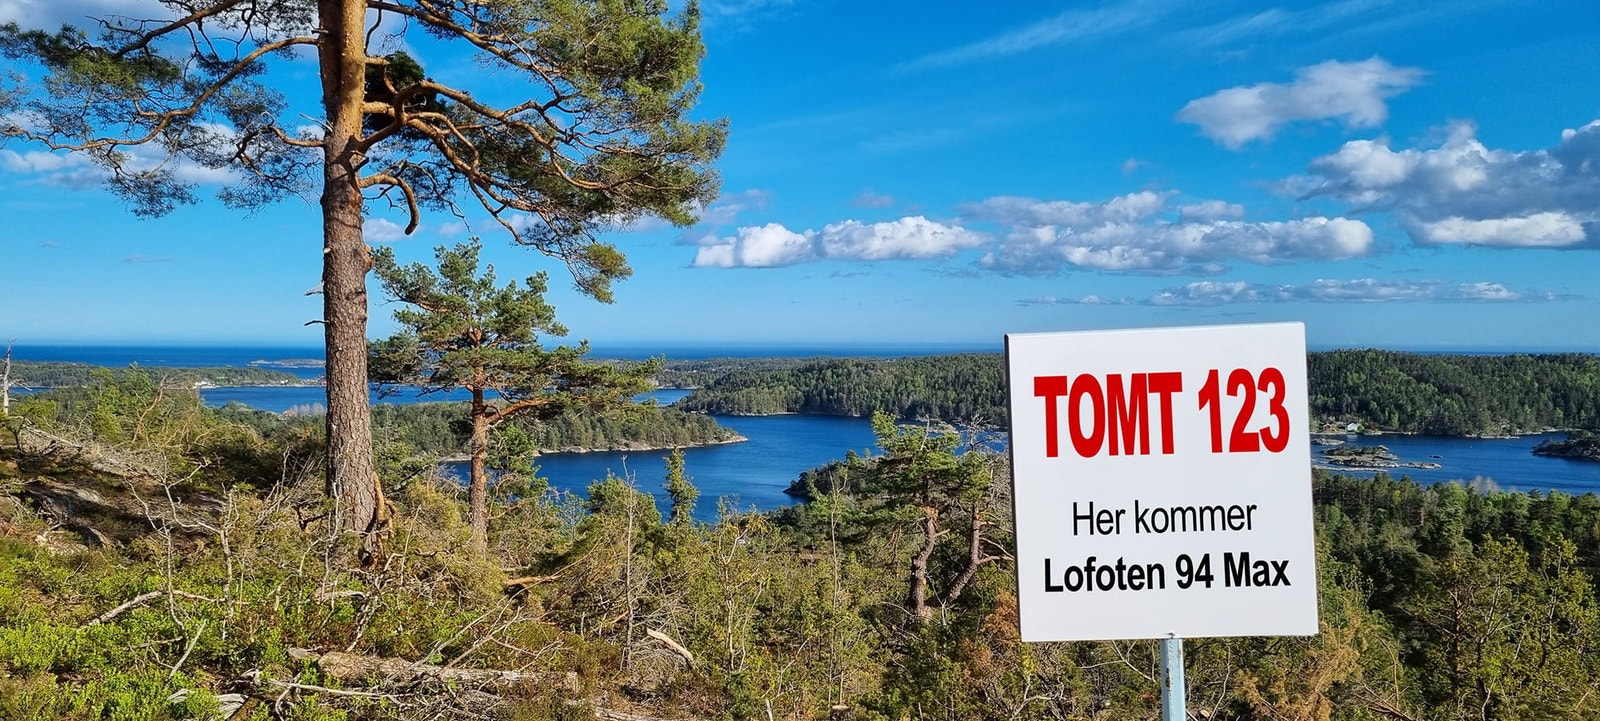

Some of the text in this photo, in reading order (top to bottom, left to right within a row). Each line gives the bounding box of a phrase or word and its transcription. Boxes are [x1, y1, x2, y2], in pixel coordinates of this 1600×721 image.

[1034, 367, 1290, 458] TOMT 123
[1073, 499, 1257, 535] Her kommer
[1044, 552, 1291, 592] Lofoten 94 Max
